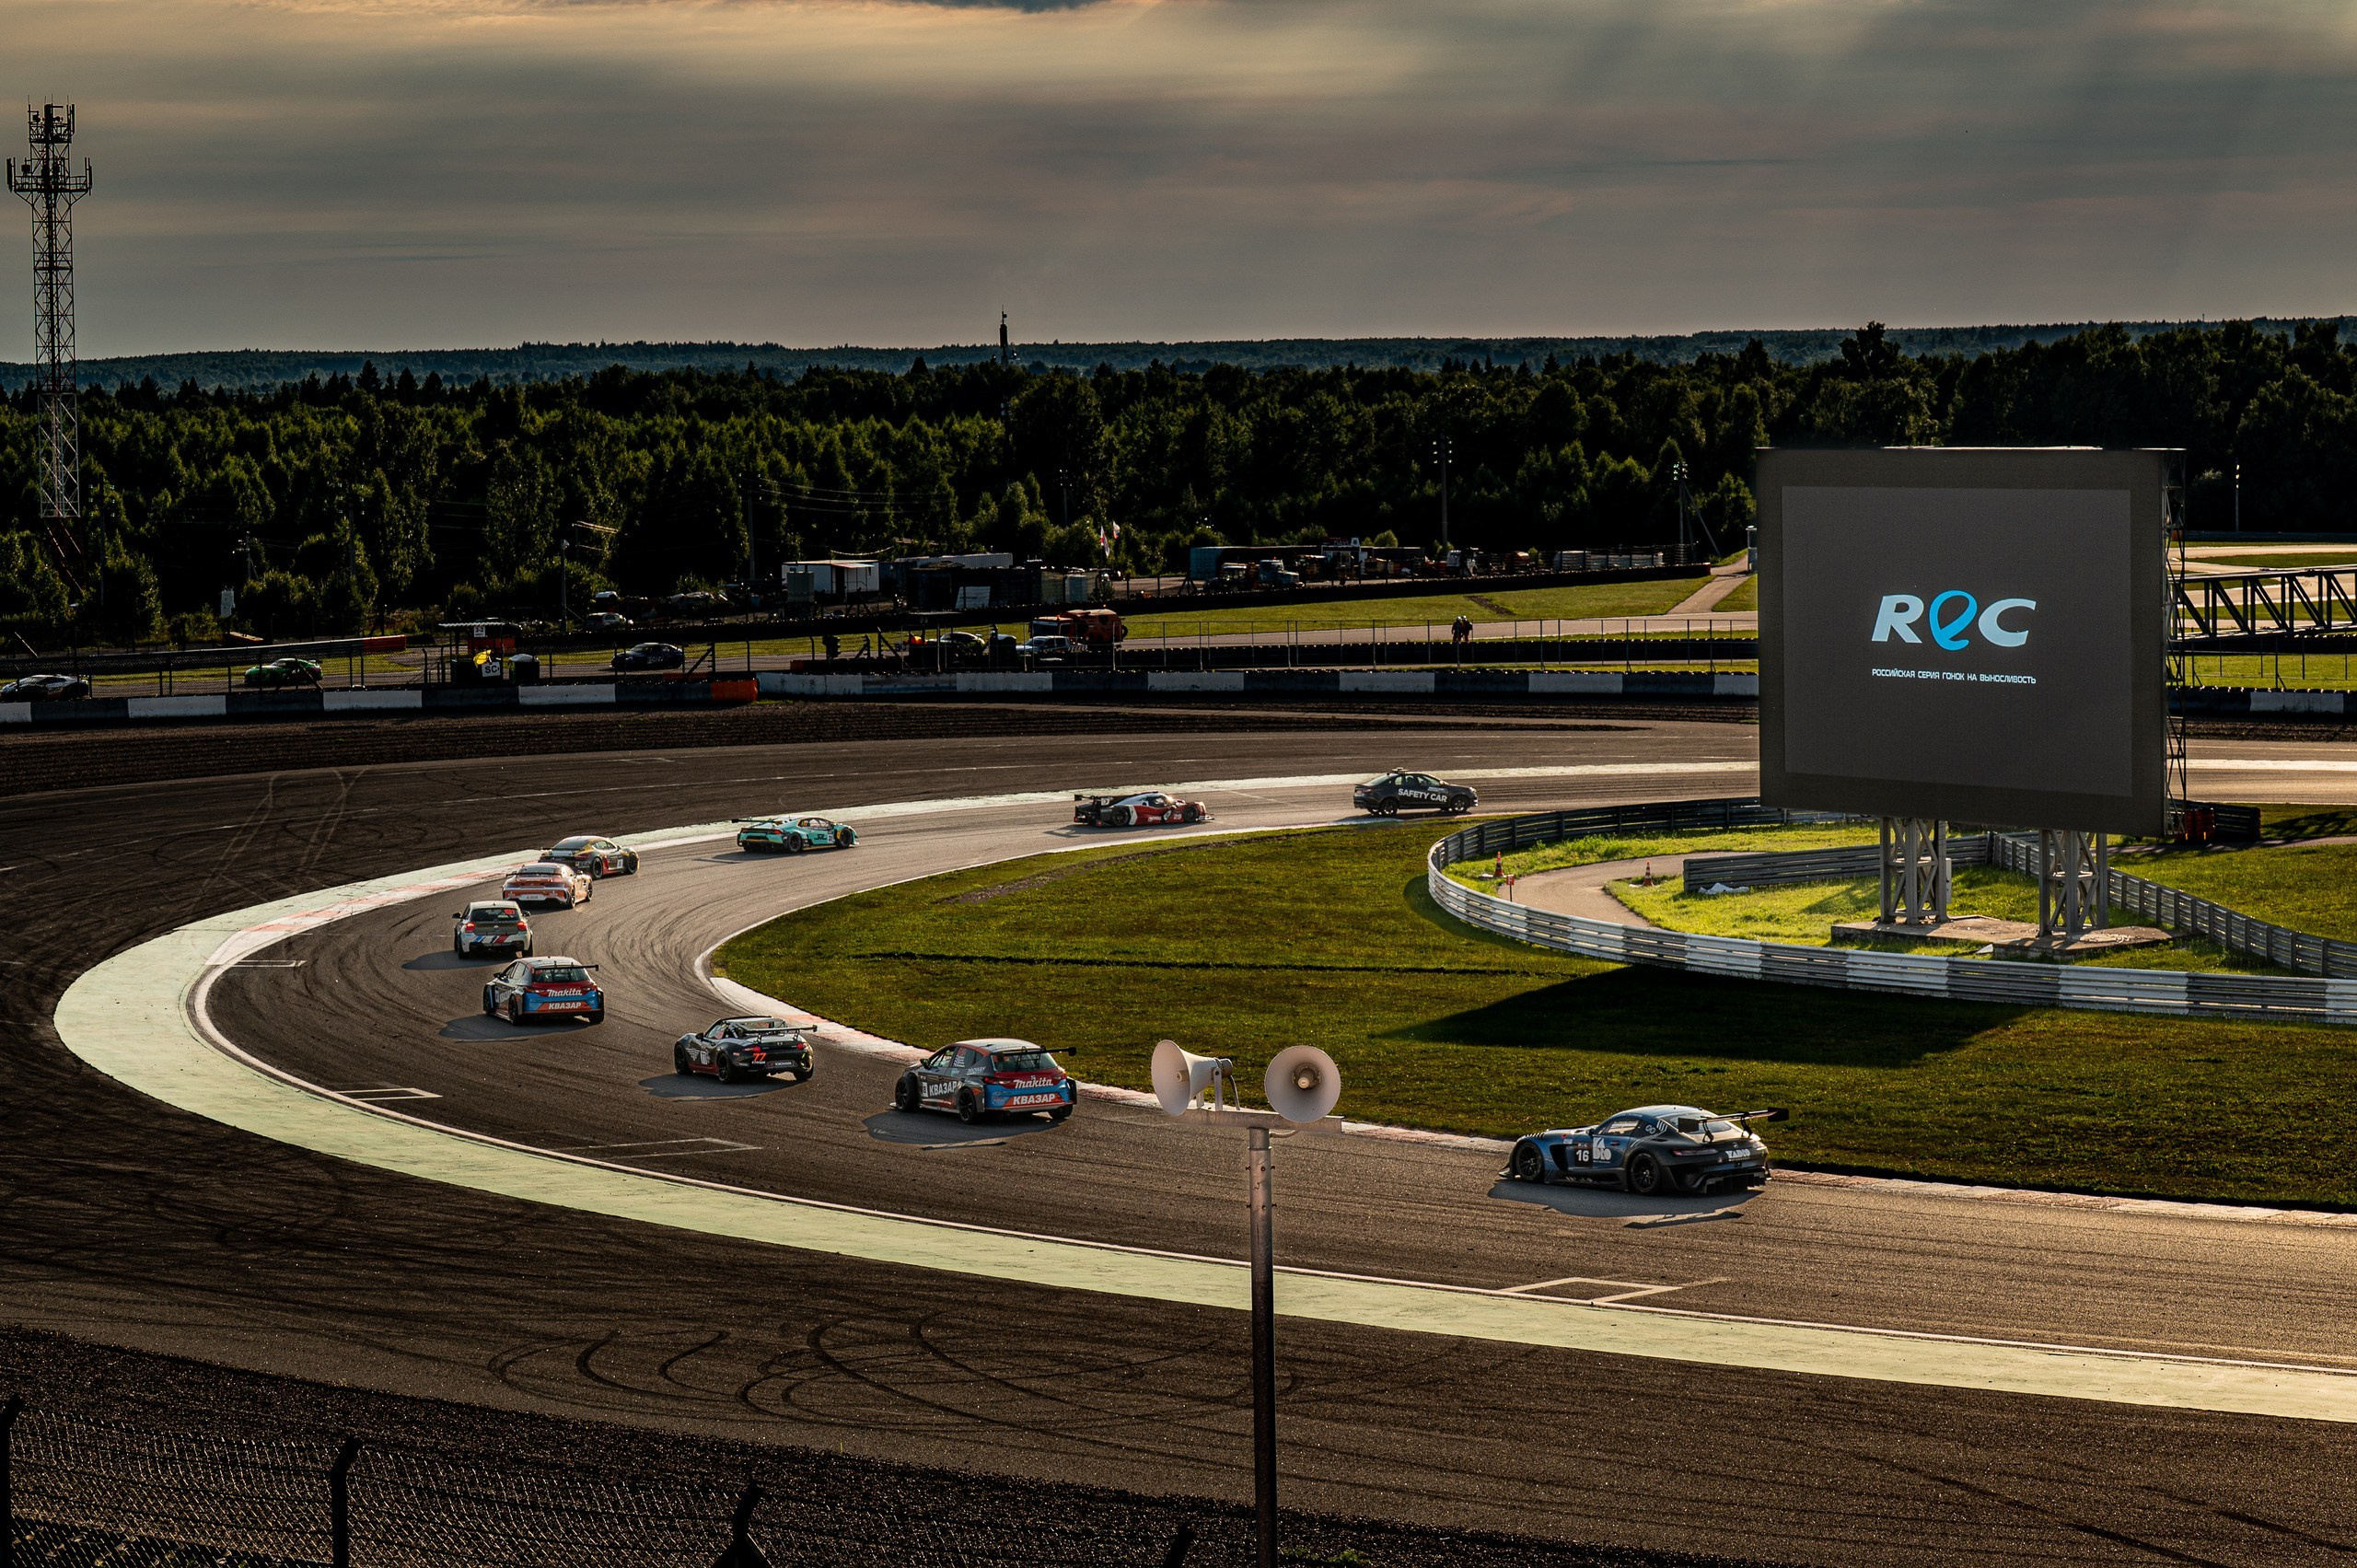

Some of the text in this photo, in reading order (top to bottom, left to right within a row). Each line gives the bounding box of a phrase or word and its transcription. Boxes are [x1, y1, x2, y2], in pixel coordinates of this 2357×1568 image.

[1872, 668, 1915, 679] РОССИЙСКАЯ
[1918, 671, 1939, 680] СЕРИЯ
[1942, 673, 1964, 681] ГОНОК
[1980, 675, 2036, 684] ВЫНОСЛИВОСТЬ
[1398, 788, 1447, 802] SAFETY CAR
[752, 1052, 766, 1061] 77
[929, 1081, 957, 1097] КВАЗАР
[1013, 1093, 1056, 1105] КВАЗАР
[1576, 1150, 1590, 1162] 16
